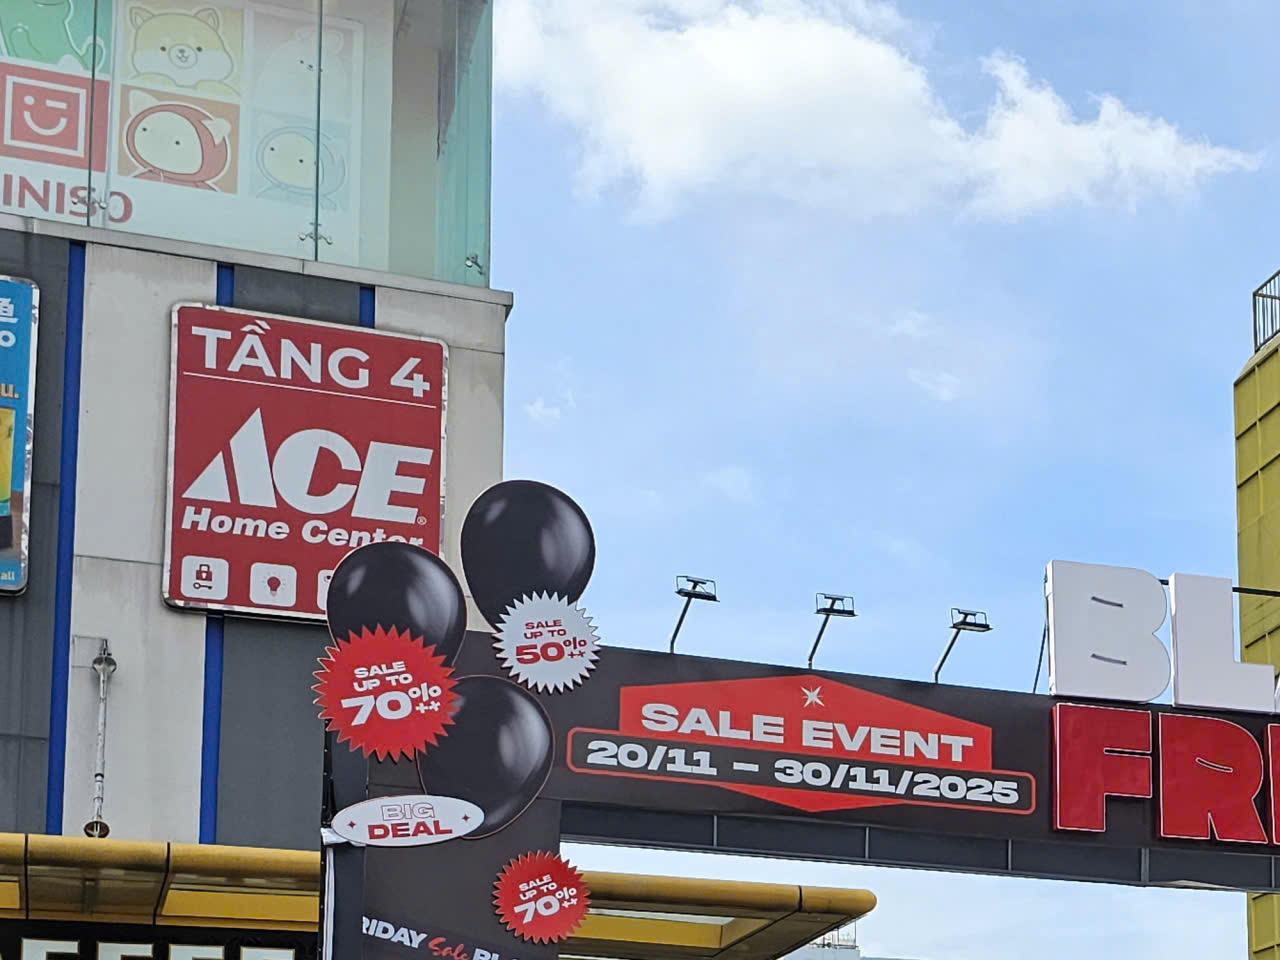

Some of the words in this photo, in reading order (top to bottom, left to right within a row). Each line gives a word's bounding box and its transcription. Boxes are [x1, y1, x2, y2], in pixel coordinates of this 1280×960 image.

[192, 321, 370, 389] TẦNG
[391, 357, 430, 398] 4
[181, 407, 434, 525] ACE
[181, 505, 290, 540] Home
[302, 519, 424, 548] Centr
[524, 630, 543, 640] UP
[551, 628, 567, 637] TO
[525, 619, 563, 630] SALE
[353, 661, 406, 680] SALE
[353, 680, 381, 693] UP
[389, 673, 413, 686] TO
[641, 702, 785, 745] SALE
[801, 719, 973, 763] EVENT
[586, 740, 718, 777] 20/11
[773, 758, 1020, 805] 30/11/2025
[380, 802, 436, 822] BIG
[367, 819, 453, 840] DEAL
[518, 874, 553, 892] SALE
[519, 889, 538, 901] UP
[540, 882, 558, 893] TO
